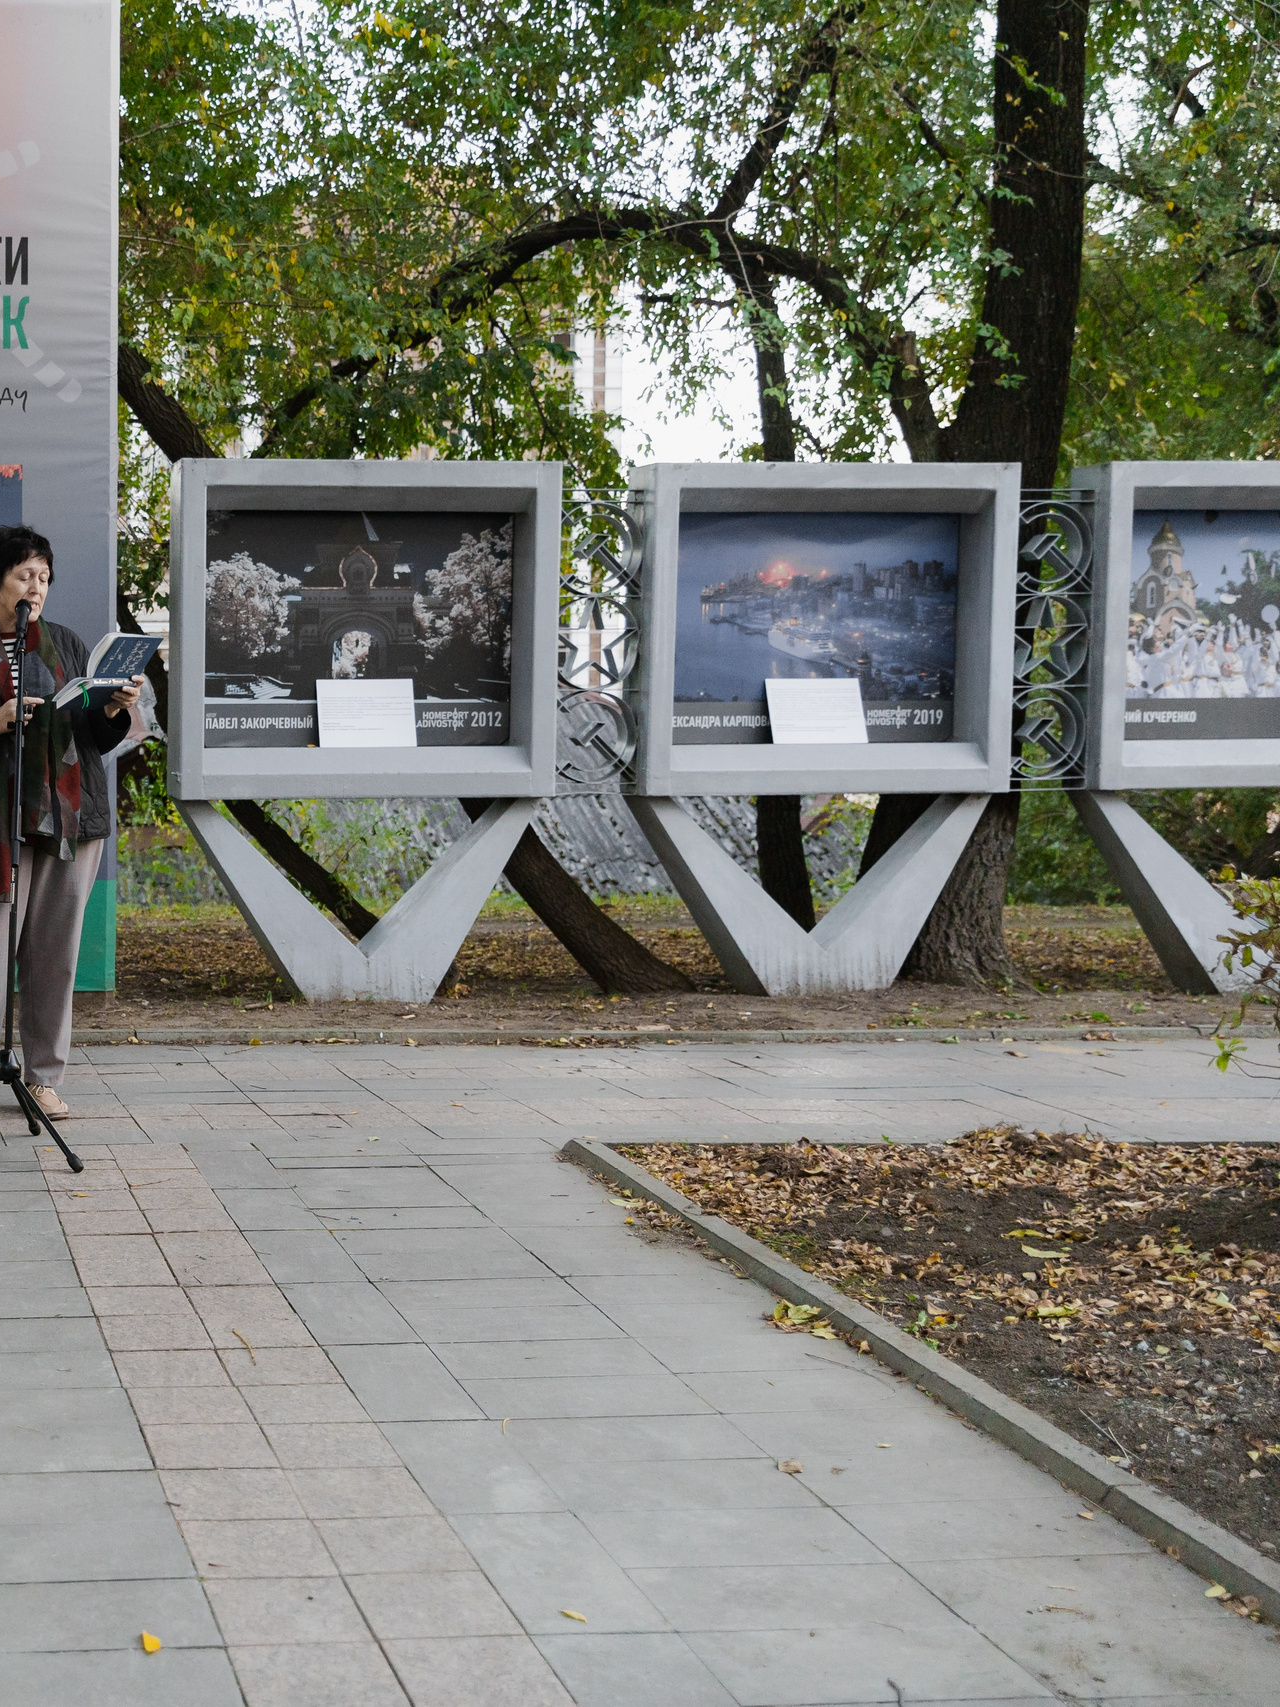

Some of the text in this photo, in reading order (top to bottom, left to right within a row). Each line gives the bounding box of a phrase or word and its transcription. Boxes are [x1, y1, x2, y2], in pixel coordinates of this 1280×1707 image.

[423, 711, 469, 720] HOMEPORT
[471, 711, 502, 727] 2012
[867, 709, 912, 718] HOMEPORT
[913, 709, 943, 725] 2019
[1143, 711, 1197, 723] КУЧЕРЕНКО
[205, 715, 313, 730] ПАВЕЛ ЗАКОРЧЕВНЫЙ
[415, 720, 464, 728] ADIVOSTOK
